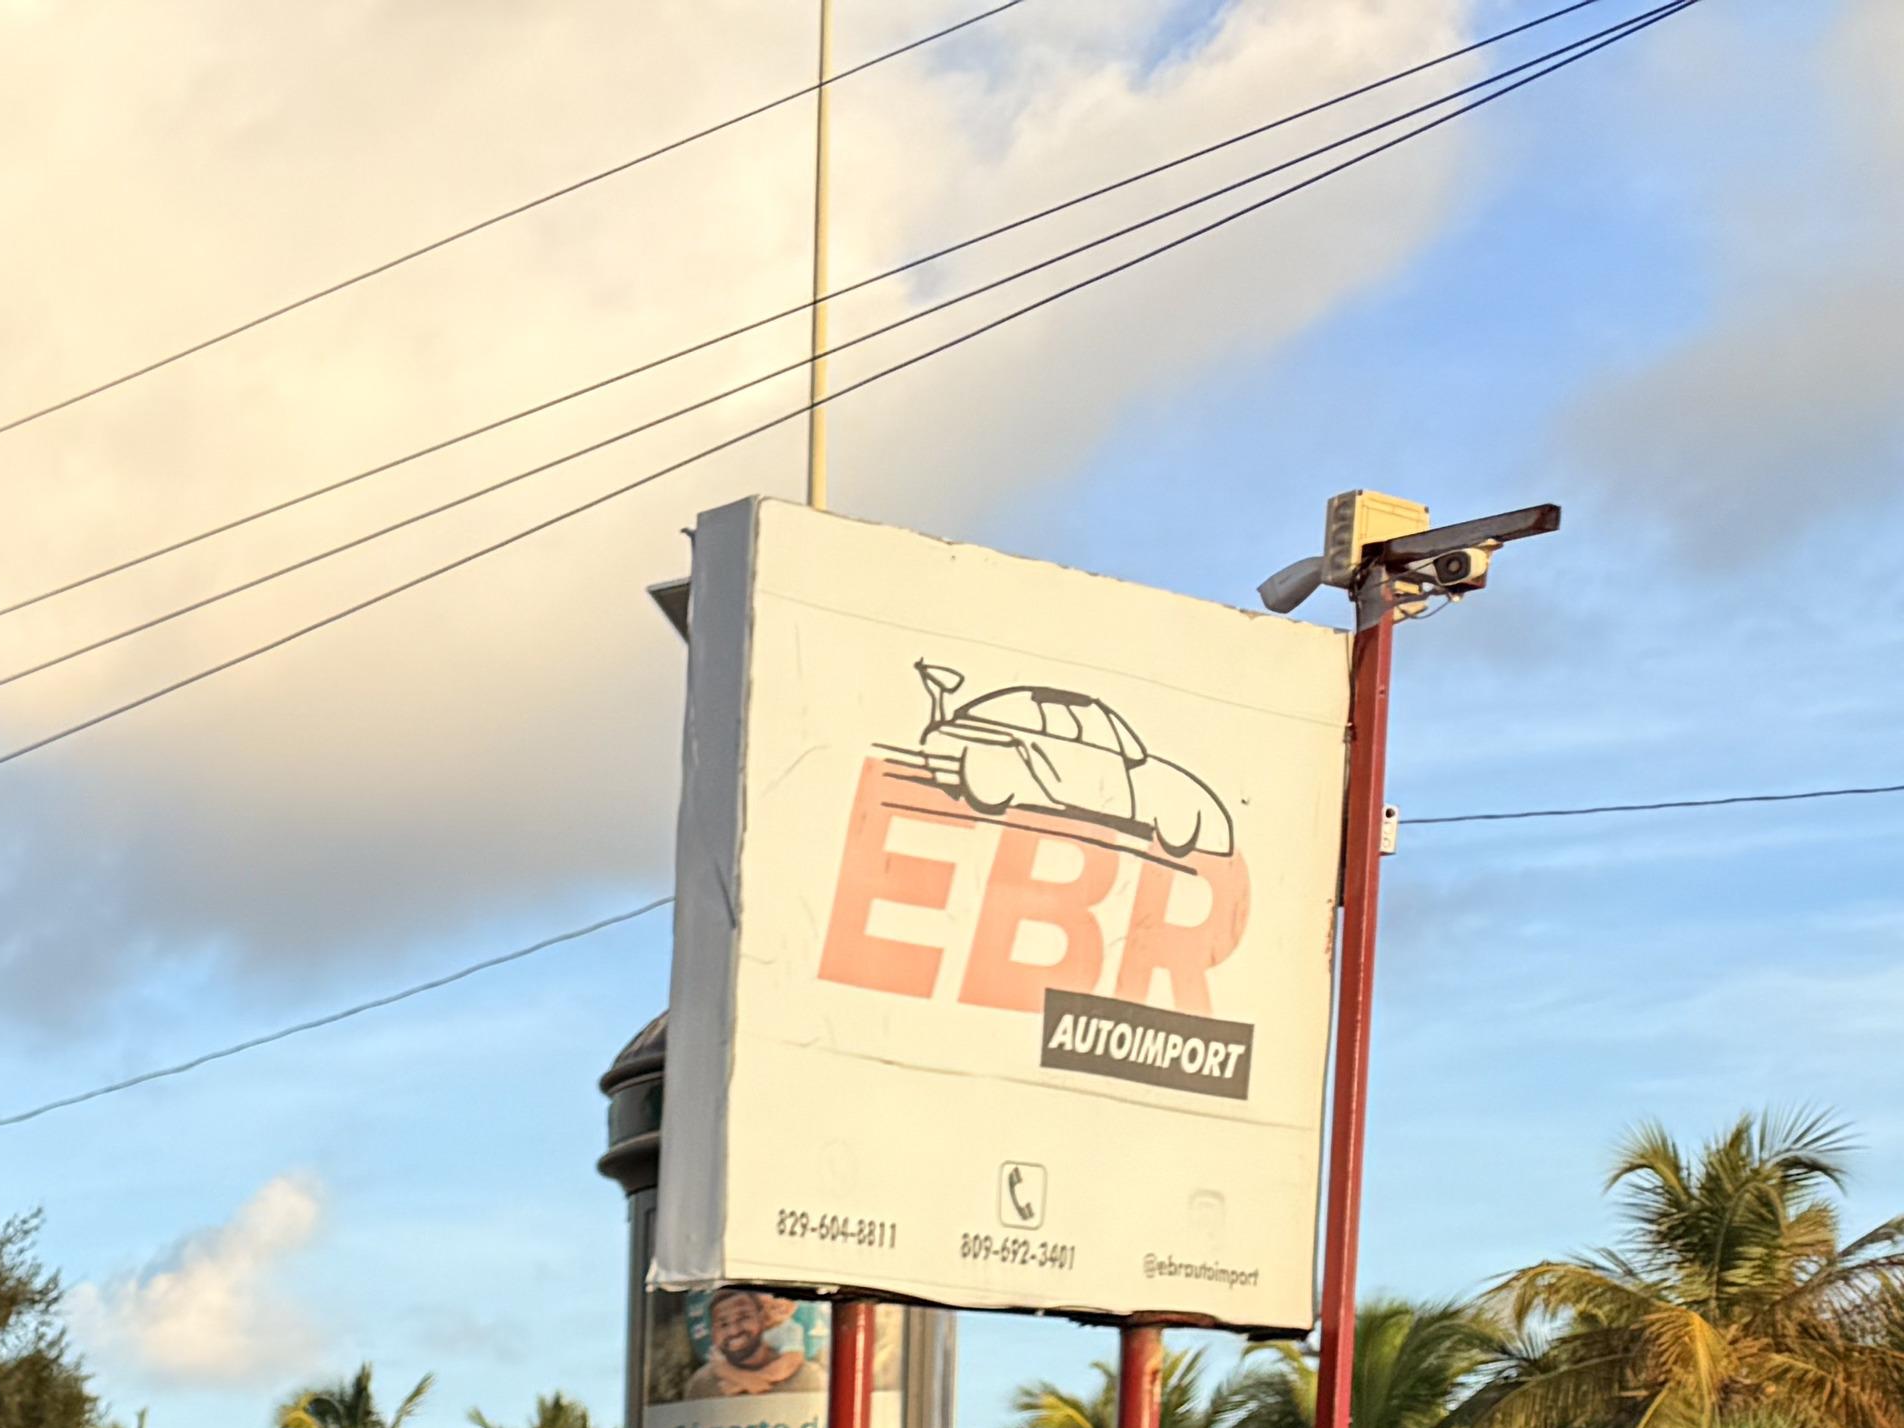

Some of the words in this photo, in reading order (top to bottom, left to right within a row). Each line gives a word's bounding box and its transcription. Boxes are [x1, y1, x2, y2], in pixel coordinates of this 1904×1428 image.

[817, 757, 1251, 1018] EBR
[1049, 1014, 1246, 1079] AUTOIMPORT
[776, 1208, 896, 1248] 829-604-8811
[1143, 1252, 1259, 1290] @ebrautoimport
